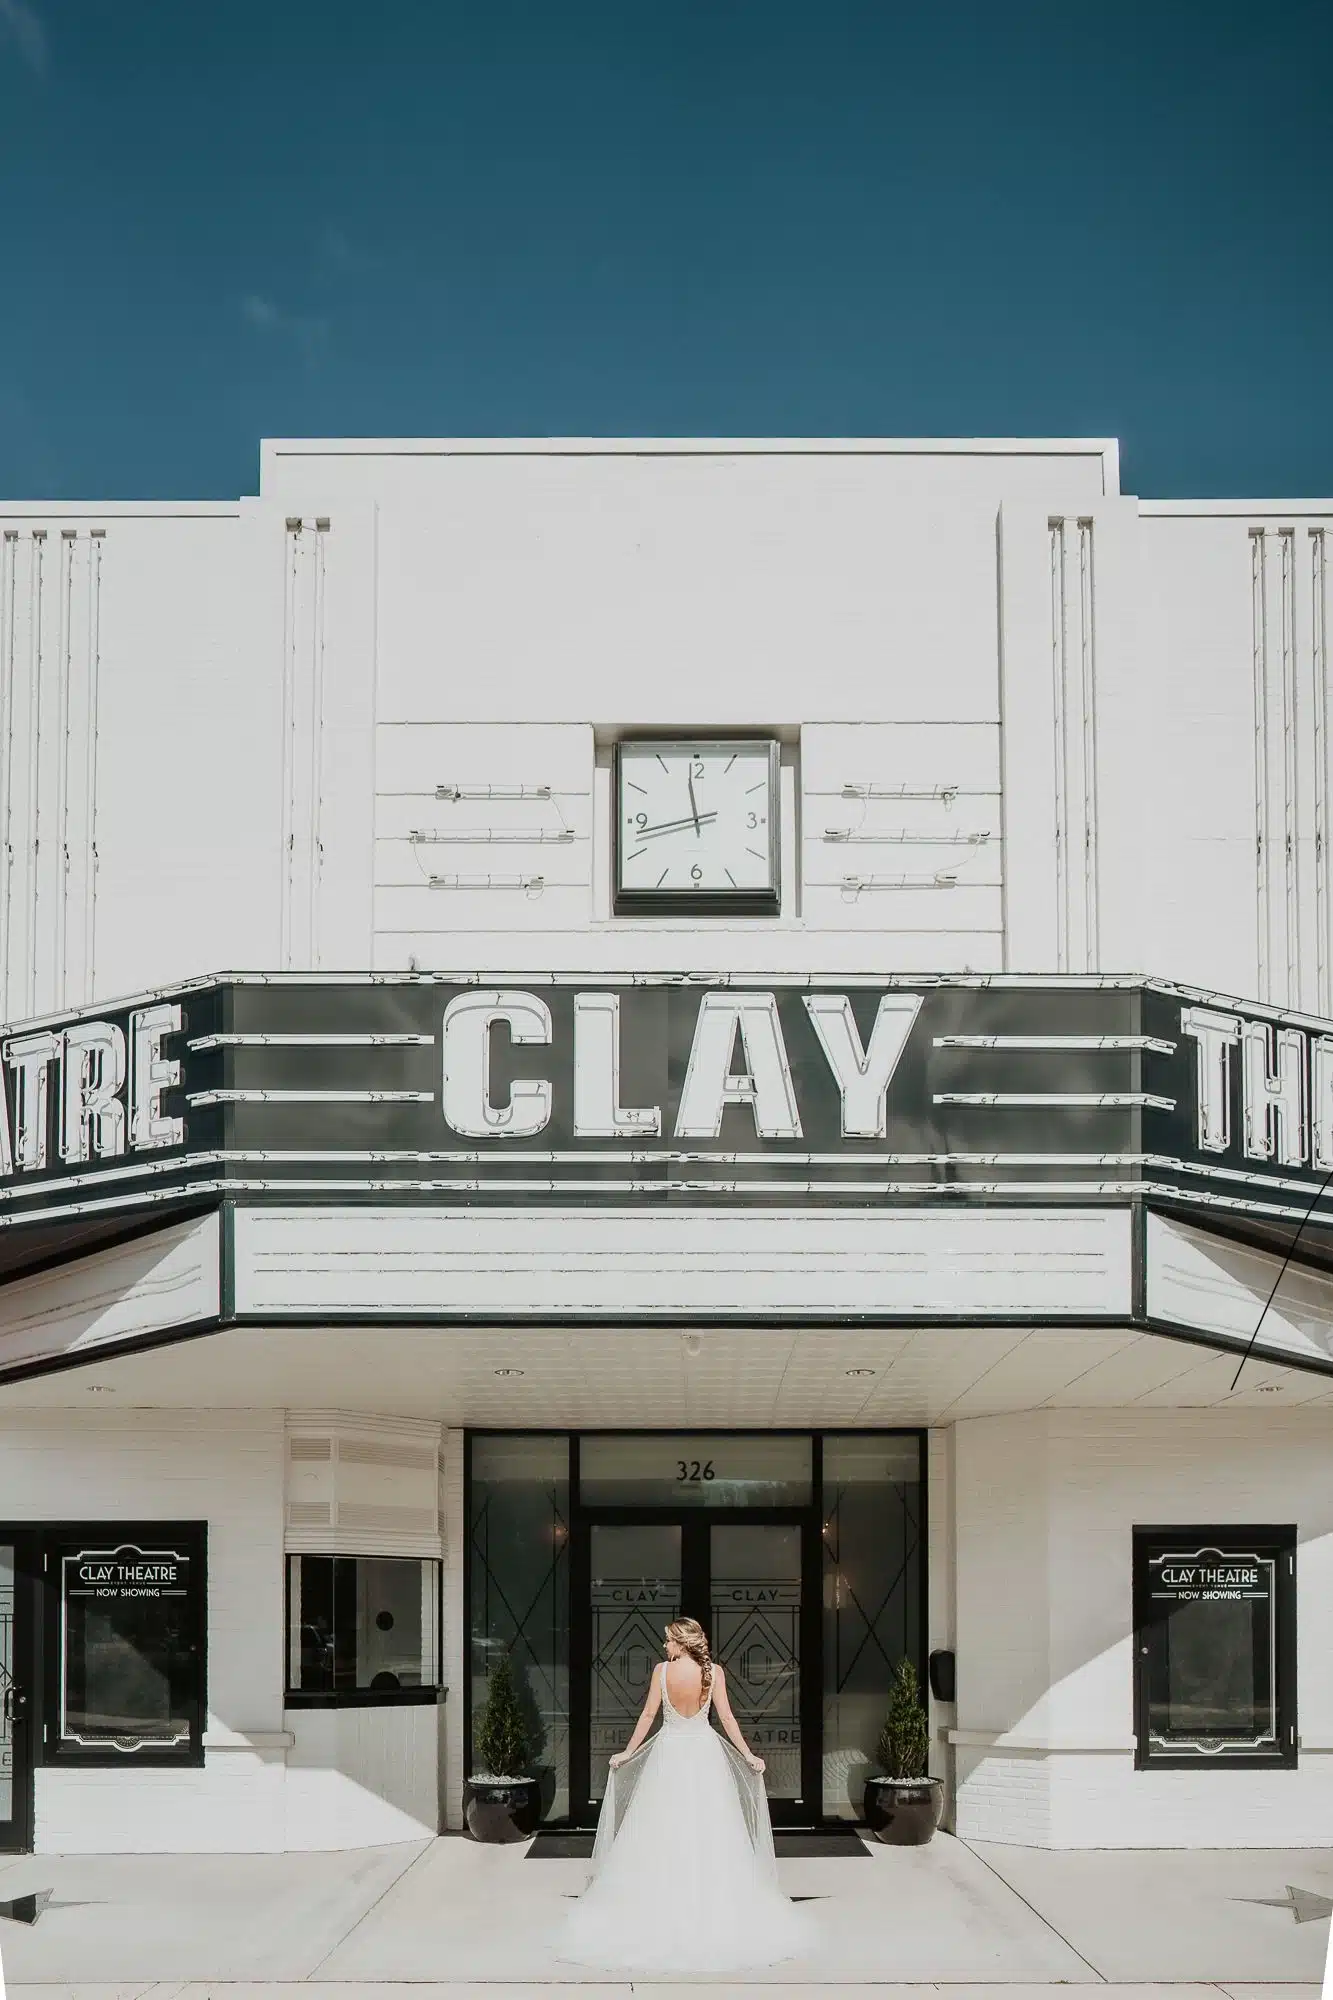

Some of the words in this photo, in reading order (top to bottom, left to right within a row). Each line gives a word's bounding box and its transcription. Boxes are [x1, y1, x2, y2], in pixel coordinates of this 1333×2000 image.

[635, 813, 648, 829] 9
[746, 812, 758, 829] 3
[690, 864, 703, 880] 6
[442, 989, 925, 1139] CLAY
[0, 1003, 184, 1176] TRE
[676, 1460, 715, 1481] 326
[79, 1566, 114, 1580] CLAY
[117, 1566, 177, 1580] THEATRE
[1161, 1569, 1196, 1583] CLAY
[1199, 1569, 1258, 1583] THEATRE
[96, 1588, 118, 1597] NOW
[120, 1588, 160, 1597] SHOWING
[612, 1589, 659, 1601] CLAY
[731, 1589, 779, 1601] CLAY
[1178, 1591, 1200, 1600] NOW
[1202, 1590, 1241, 1600] SHOWING
